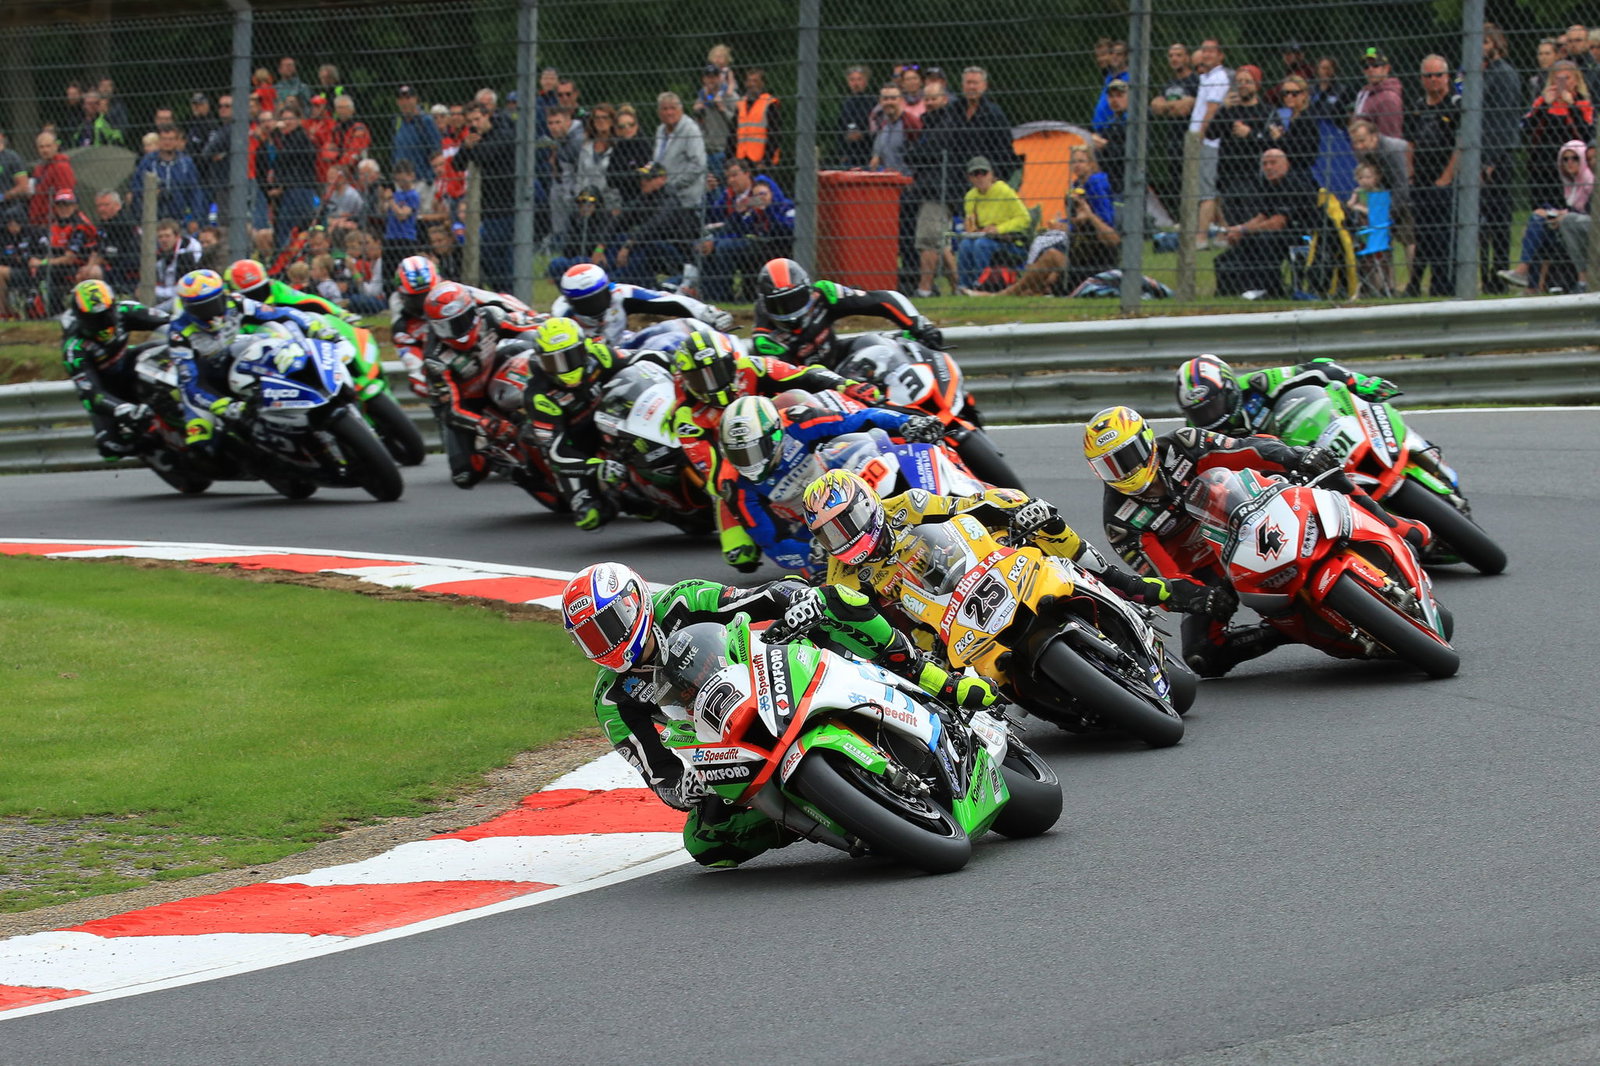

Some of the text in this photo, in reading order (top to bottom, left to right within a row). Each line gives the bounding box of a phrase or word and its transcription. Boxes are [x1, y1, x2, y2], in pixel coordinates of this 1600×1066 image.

[263, 388, 300, 401] tyco
[898, 367, 925, 401] 3
[1371, 404, 1395, 439] OXFORD
[1097, 431, 1116, 444] SHOEI
[1238, 486, 1279, 517] Racing
[955, 571, 981, 597] Hire
[980, 551, 1003, 571] Ltd
[1007, 555, 1029, 582] R&G
[569, 598, 589, 614] SHOEI
[963, 573, 1008, 631] 25
[678, 645, 700, 671] LUKE
[954, 630, 976, 656] R&G
[753, 653, 769, 696] Speedfit
[770, 648, 787, 694] OXFORD
[701, 682, 745, 735] 12
[868, 698, 918, 728] Speedfit
[703, 748, 739, 763] Speedfit
[706, 766, 750, 782] OXFORD
